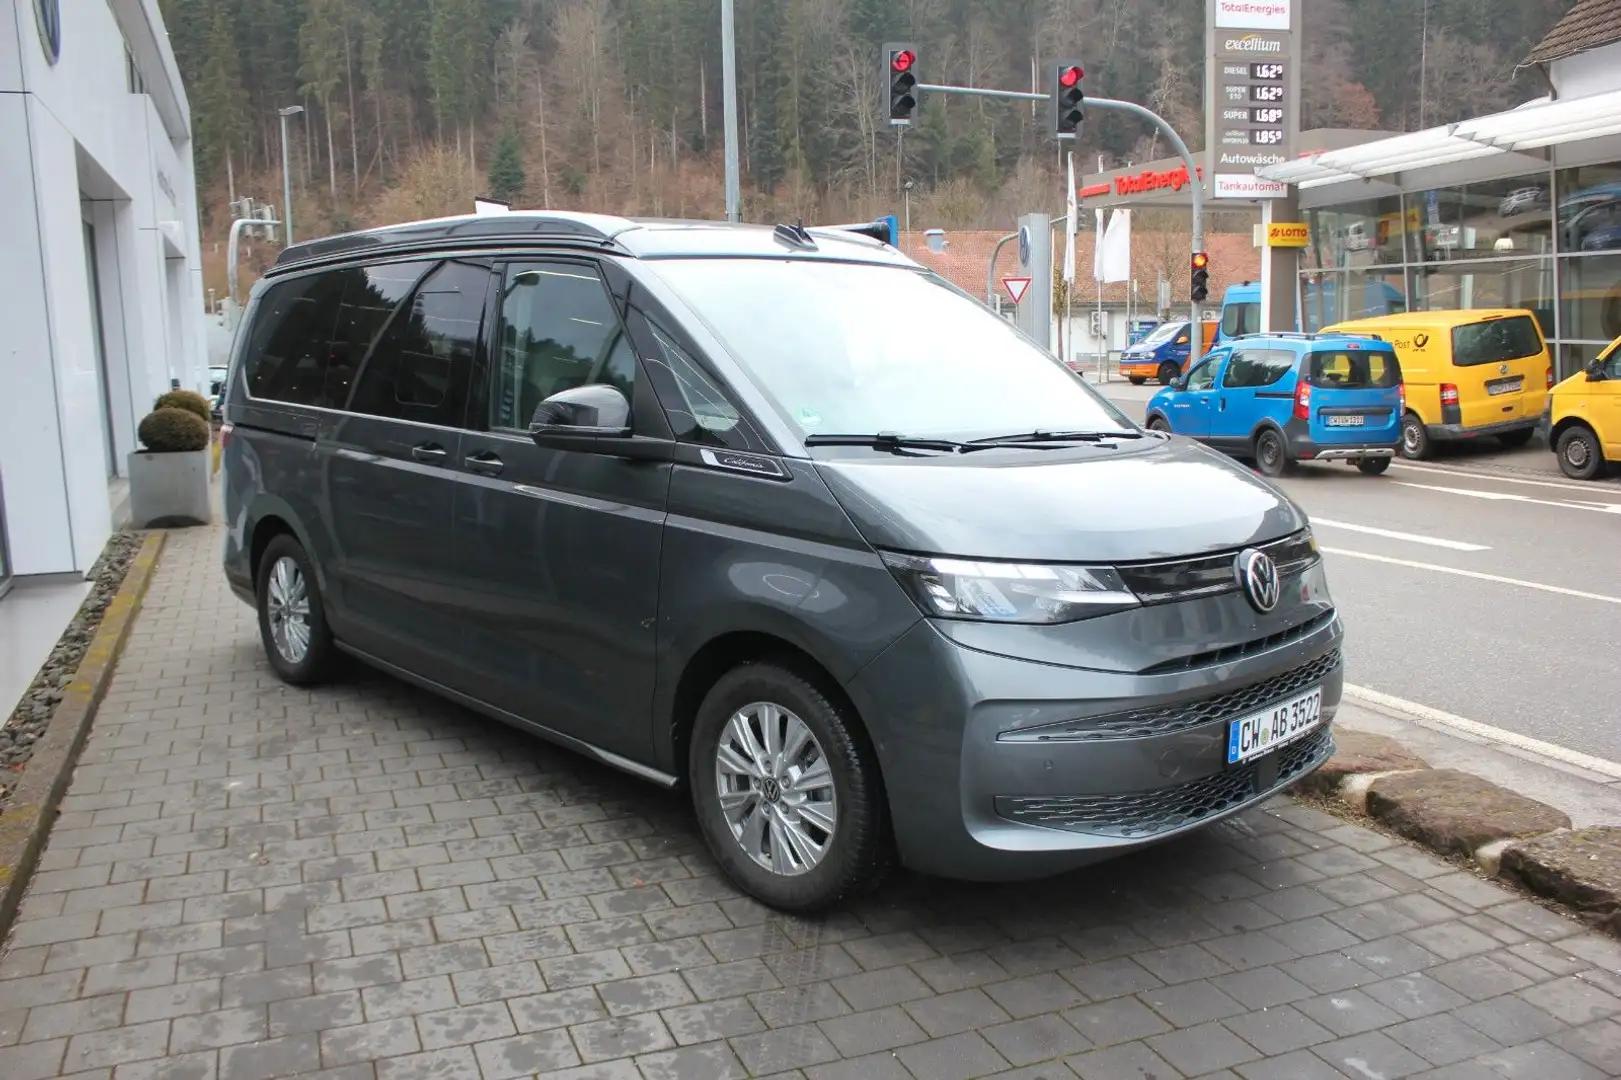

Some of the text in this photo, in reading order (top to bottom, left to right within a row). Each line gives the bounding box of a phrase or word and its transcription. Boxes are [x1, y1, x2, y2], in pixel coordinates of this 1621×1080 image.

[1221, 3, 1286, 15] TotalEnergies
[1225, 37, 1280, 52] excellium
[1224, 66, 1247, 75] DIESEL
[1223, 110, 1248, 119] SUPER
[1220, 152, 1285, 164] Autowäsche
[1218, 180, 1284, 191] Tankautomat
[1281, 228, 1307, 237] LOTTO
[1394, 339, 1410, 349] Post
[1231, 745, 1237, 755] D
[1271, 707, 1288, 741] AB
[1290, 692, 1320, 731] 3522
